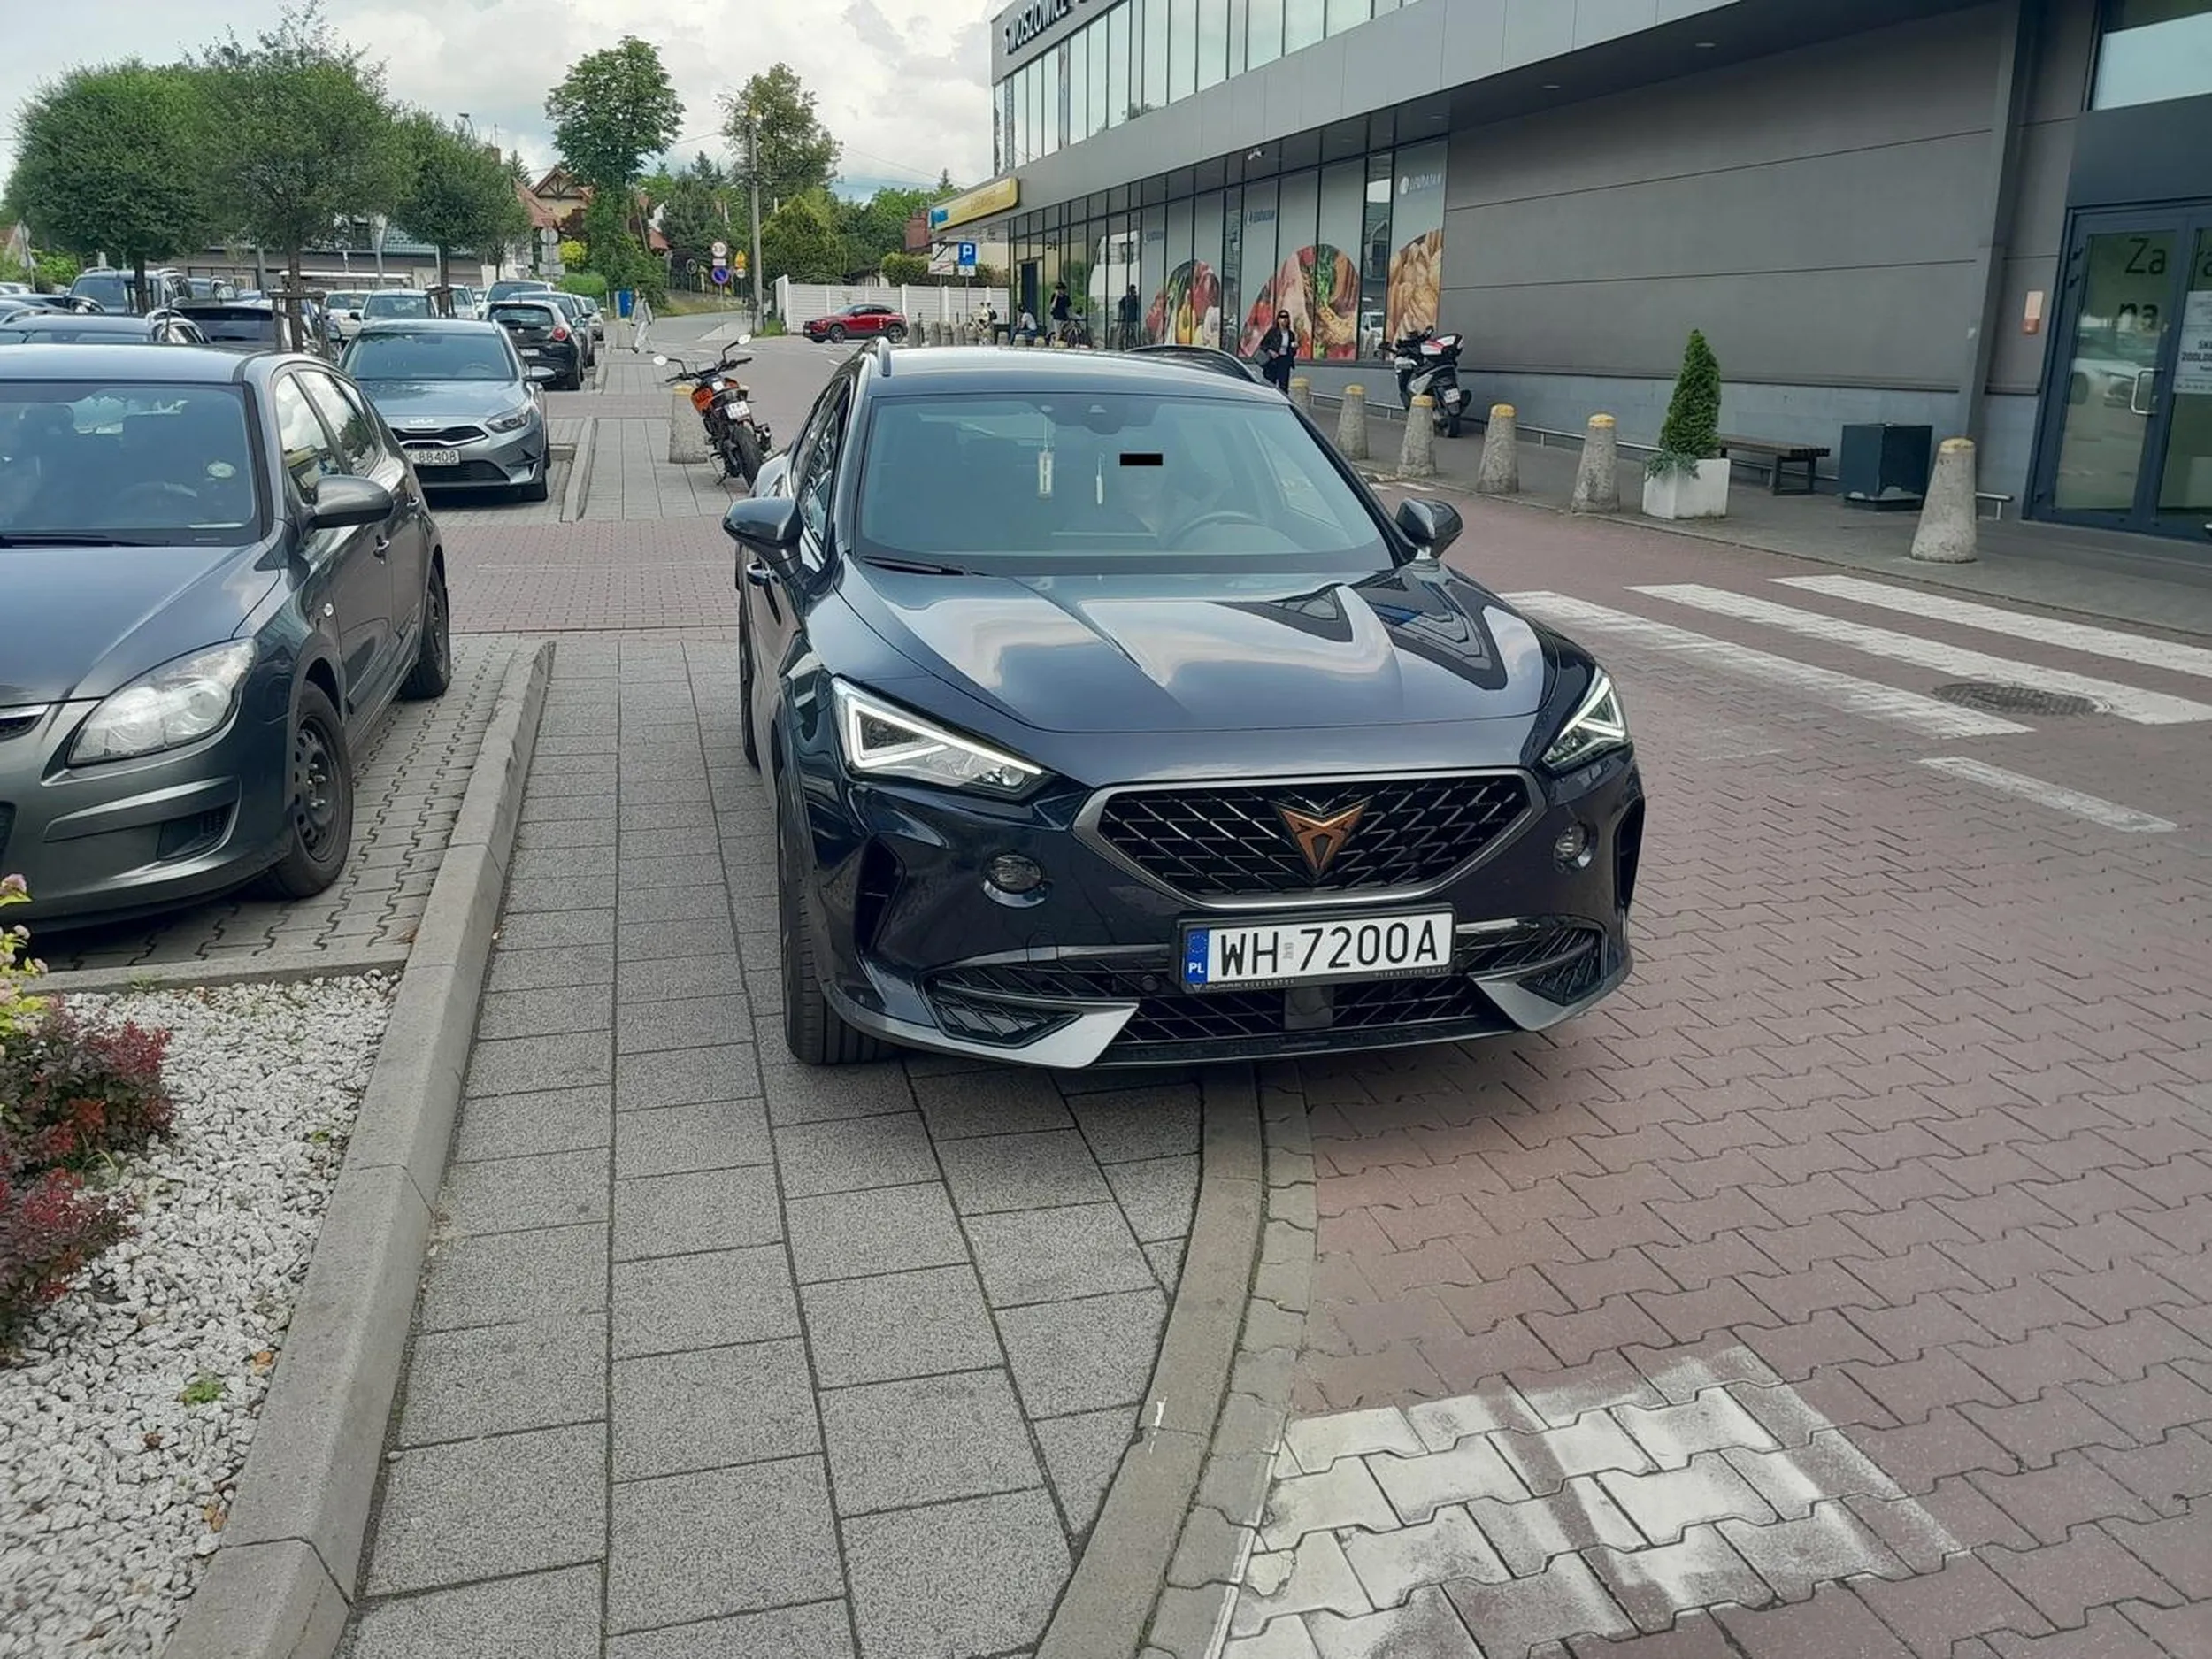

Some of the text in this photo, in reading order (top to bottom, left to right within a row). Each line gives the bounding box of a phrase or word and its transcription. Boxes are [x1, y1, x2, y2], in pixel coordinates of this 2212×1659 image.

[963, 244, 973, 258] P
[1220, 919, 1439, 977] WH 7200A
[1188, 962, 1205, 974] PL
